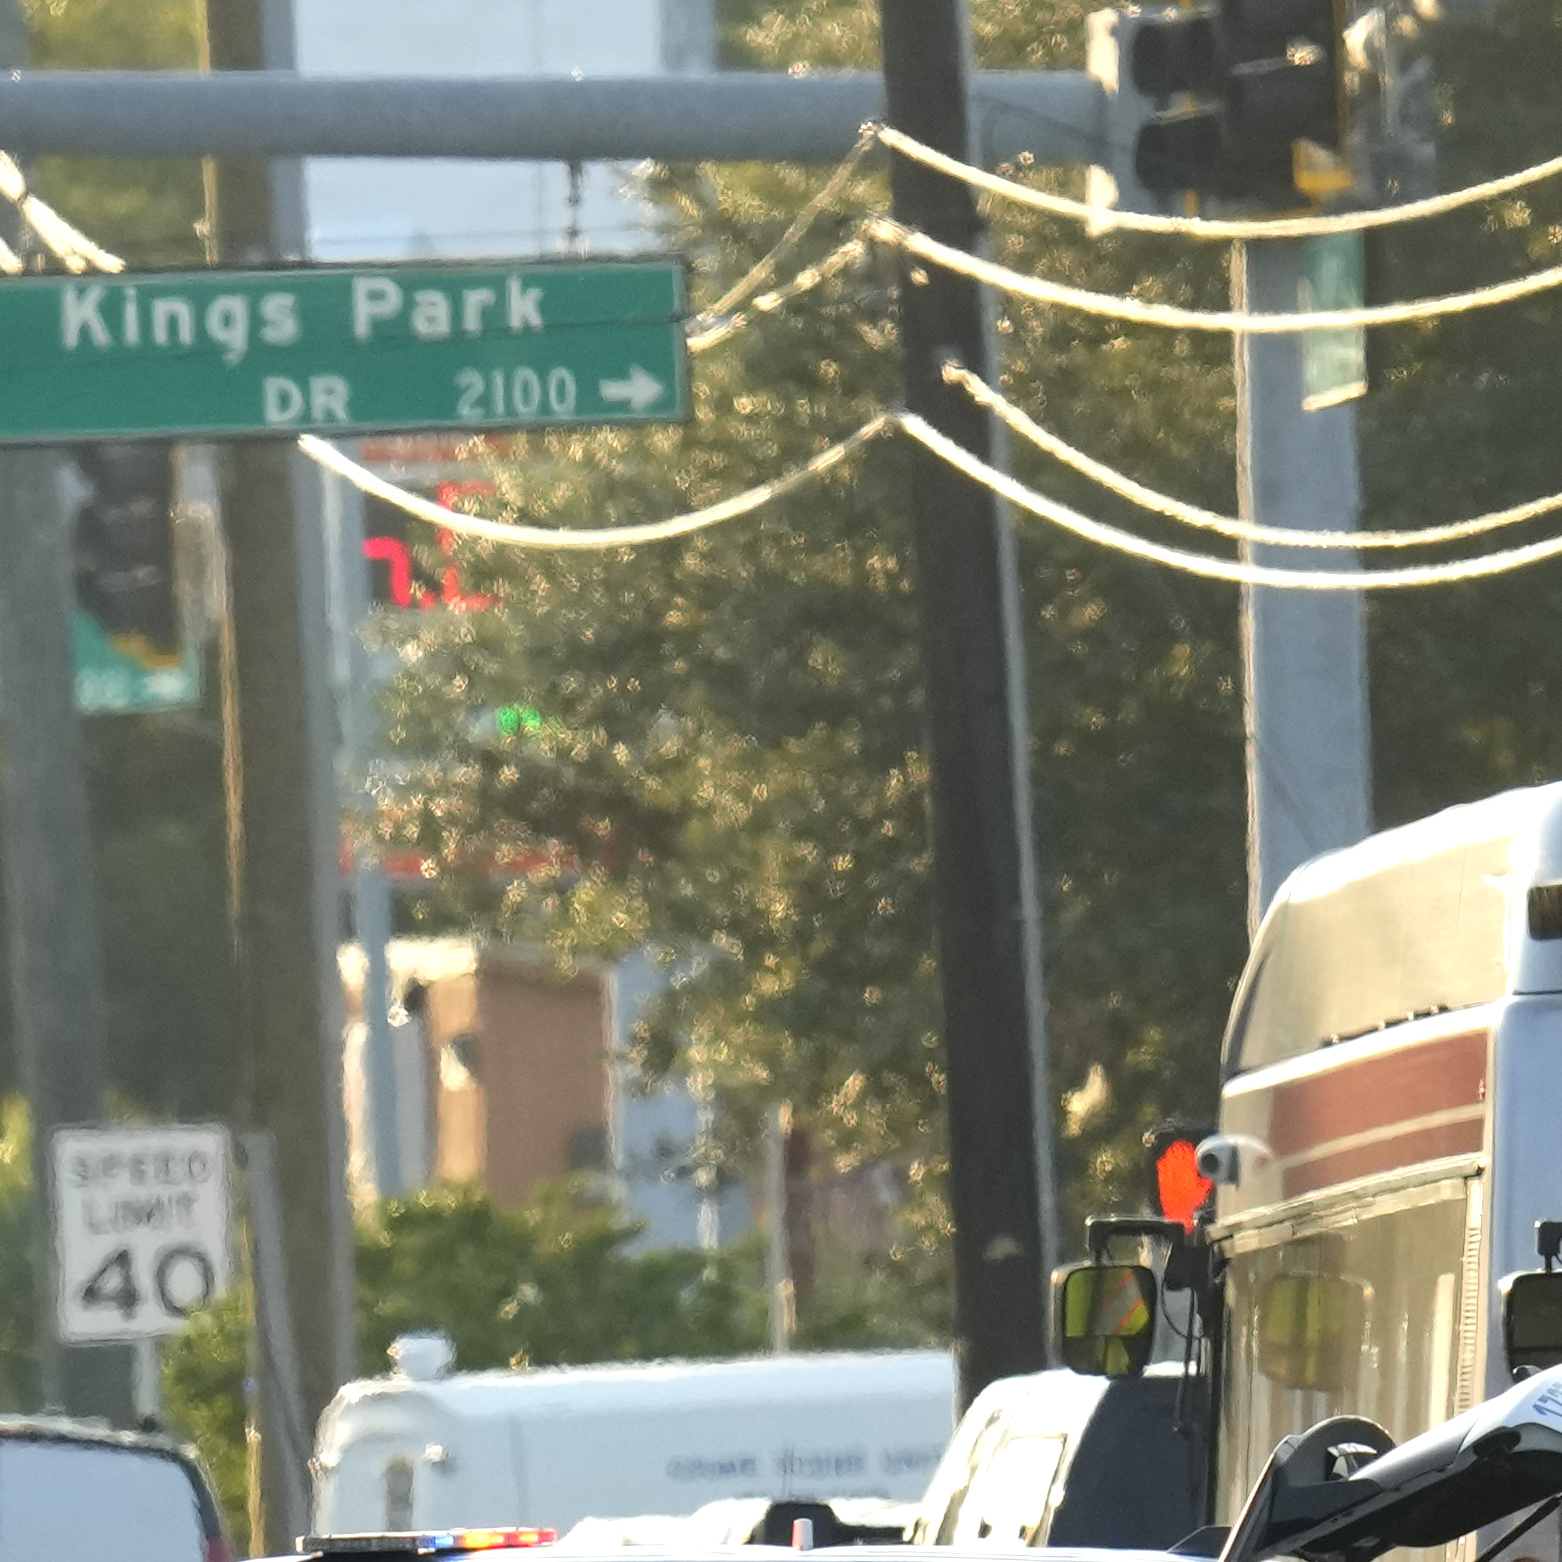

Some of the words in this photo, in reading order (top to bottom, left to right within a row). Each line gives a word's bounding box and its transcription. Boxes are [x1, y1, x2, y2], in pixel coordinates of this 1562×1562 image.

[60, 284, 302, 365] Kings
[351, 275, 545, 344] Park
[262, 373, 351, 425] DR
[454, 367, 578, 419] 2100
[80, 1243, 215, 1321] 40
